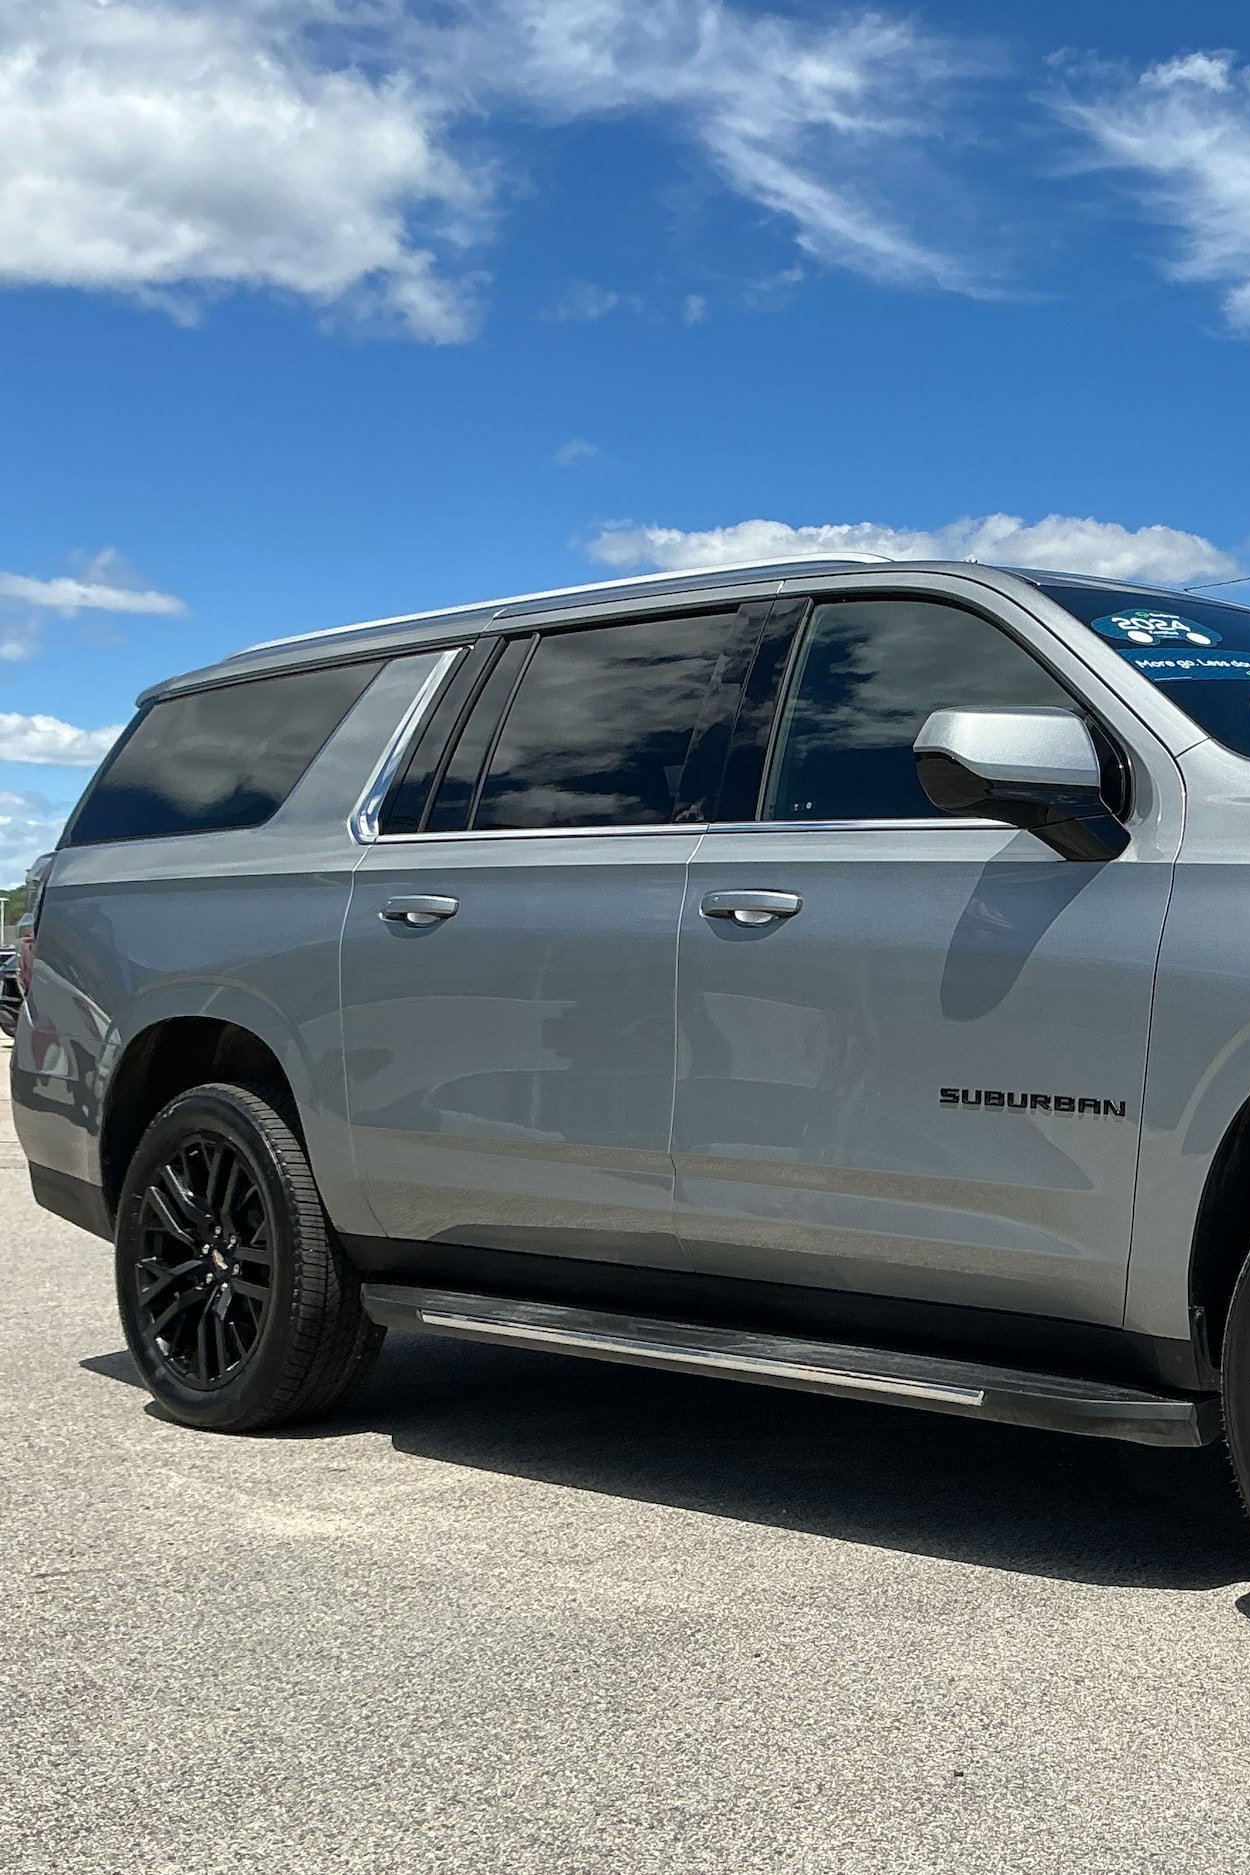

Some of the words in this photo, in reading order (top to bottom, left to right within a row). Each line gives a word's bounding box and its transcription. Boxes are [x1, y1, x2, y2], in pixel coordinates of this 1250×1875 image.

[1111, 617, 1191, 632] 2024
[1135, 659, 1175, 669] More
[939, 1087, 1126, 1117] SUBURBAN
